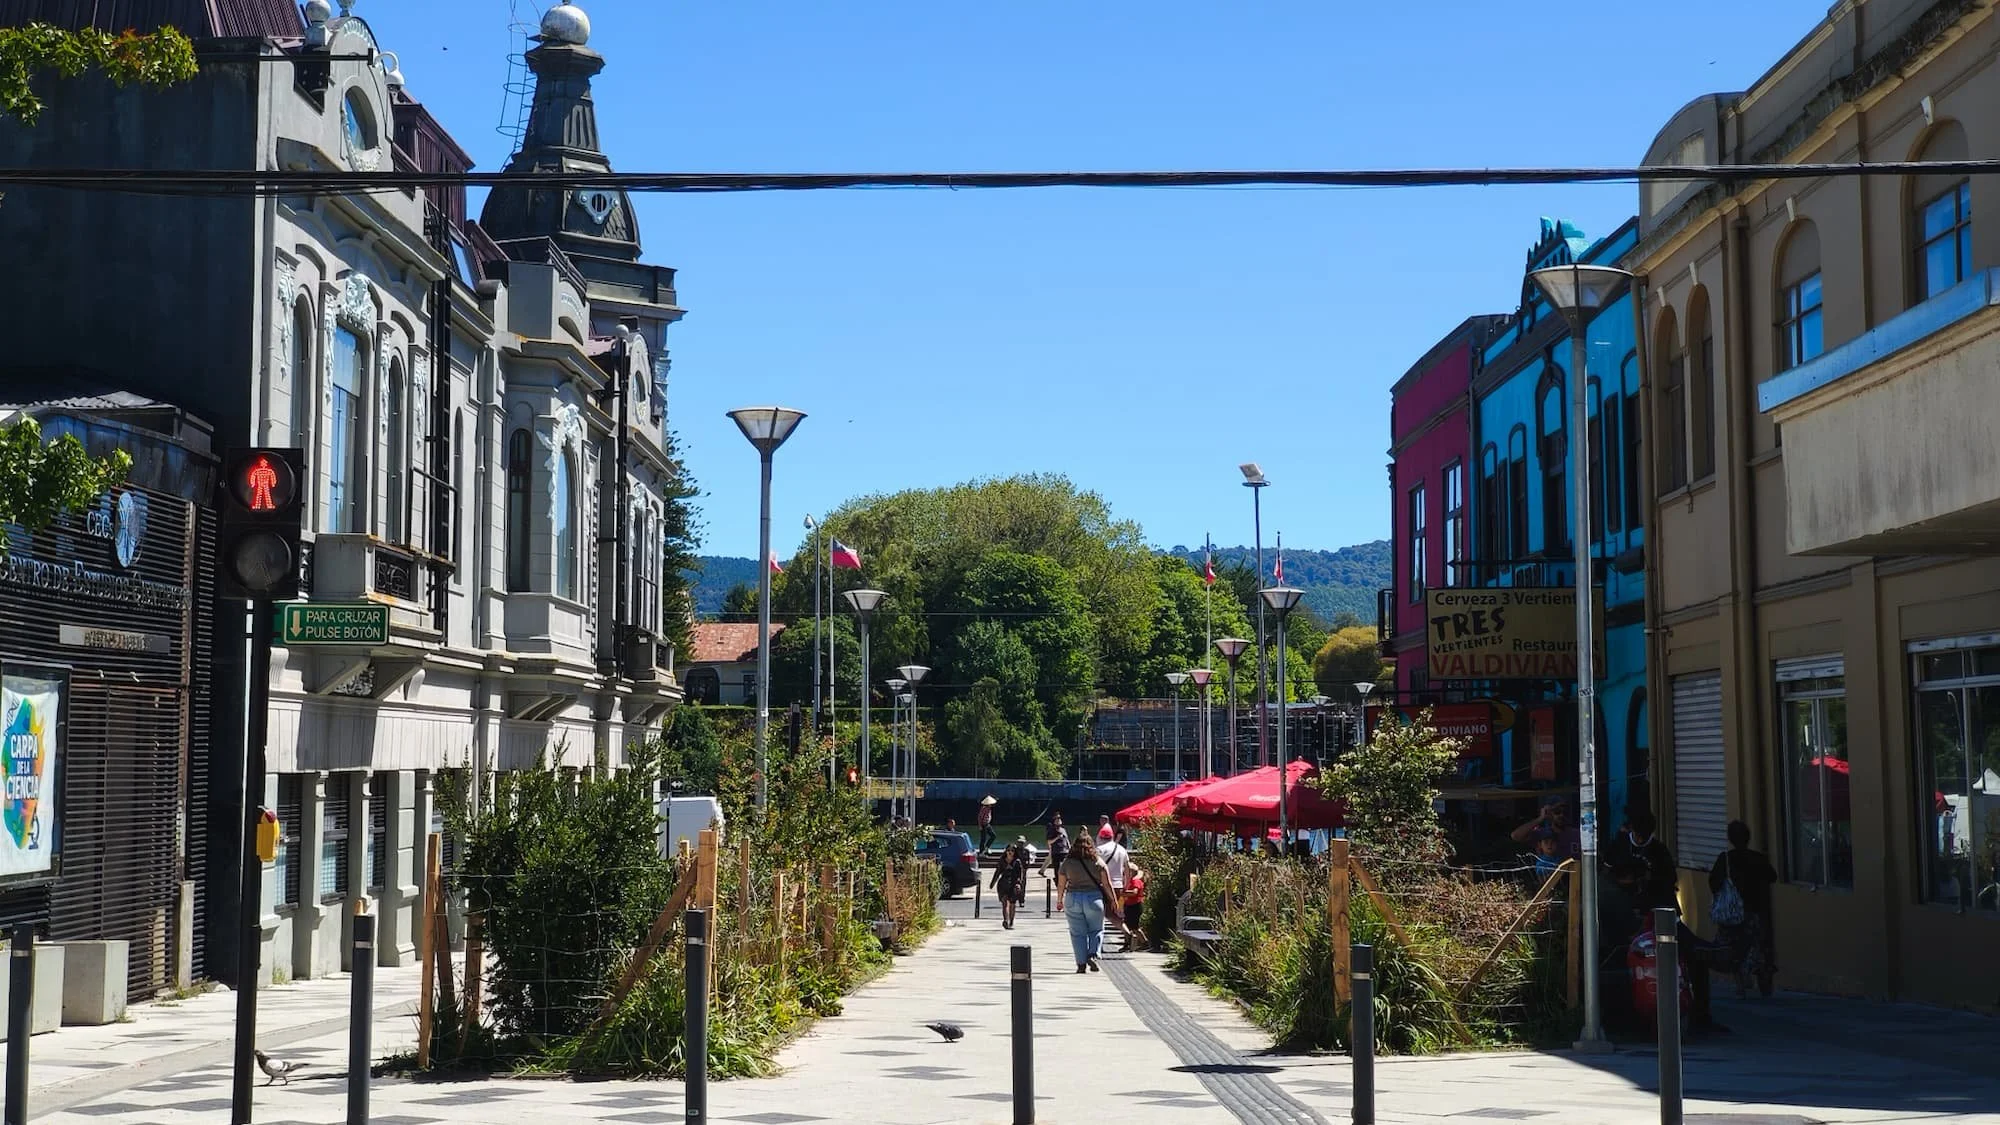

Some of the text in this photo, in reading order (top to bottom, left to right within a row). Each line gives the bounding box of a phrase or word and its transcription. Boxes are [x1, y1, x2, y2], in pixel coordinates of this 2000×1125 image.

[1435, 592, 1497, 605] Cerveza
[1502, 592, 1510, 605] 3
[306, 611, 381, 623] PARA CRUZAR
[1430, 606, 1505, 641] TRES
[305, 624, 381, 638] PULSE BOTÓN
[1512, 638, 1600, 651] Restaurt
[11, 735, 38, 759] CARPA
[17, 761, 30, 774] DE LA
[7, 776, 38, 800] CIENCIA
